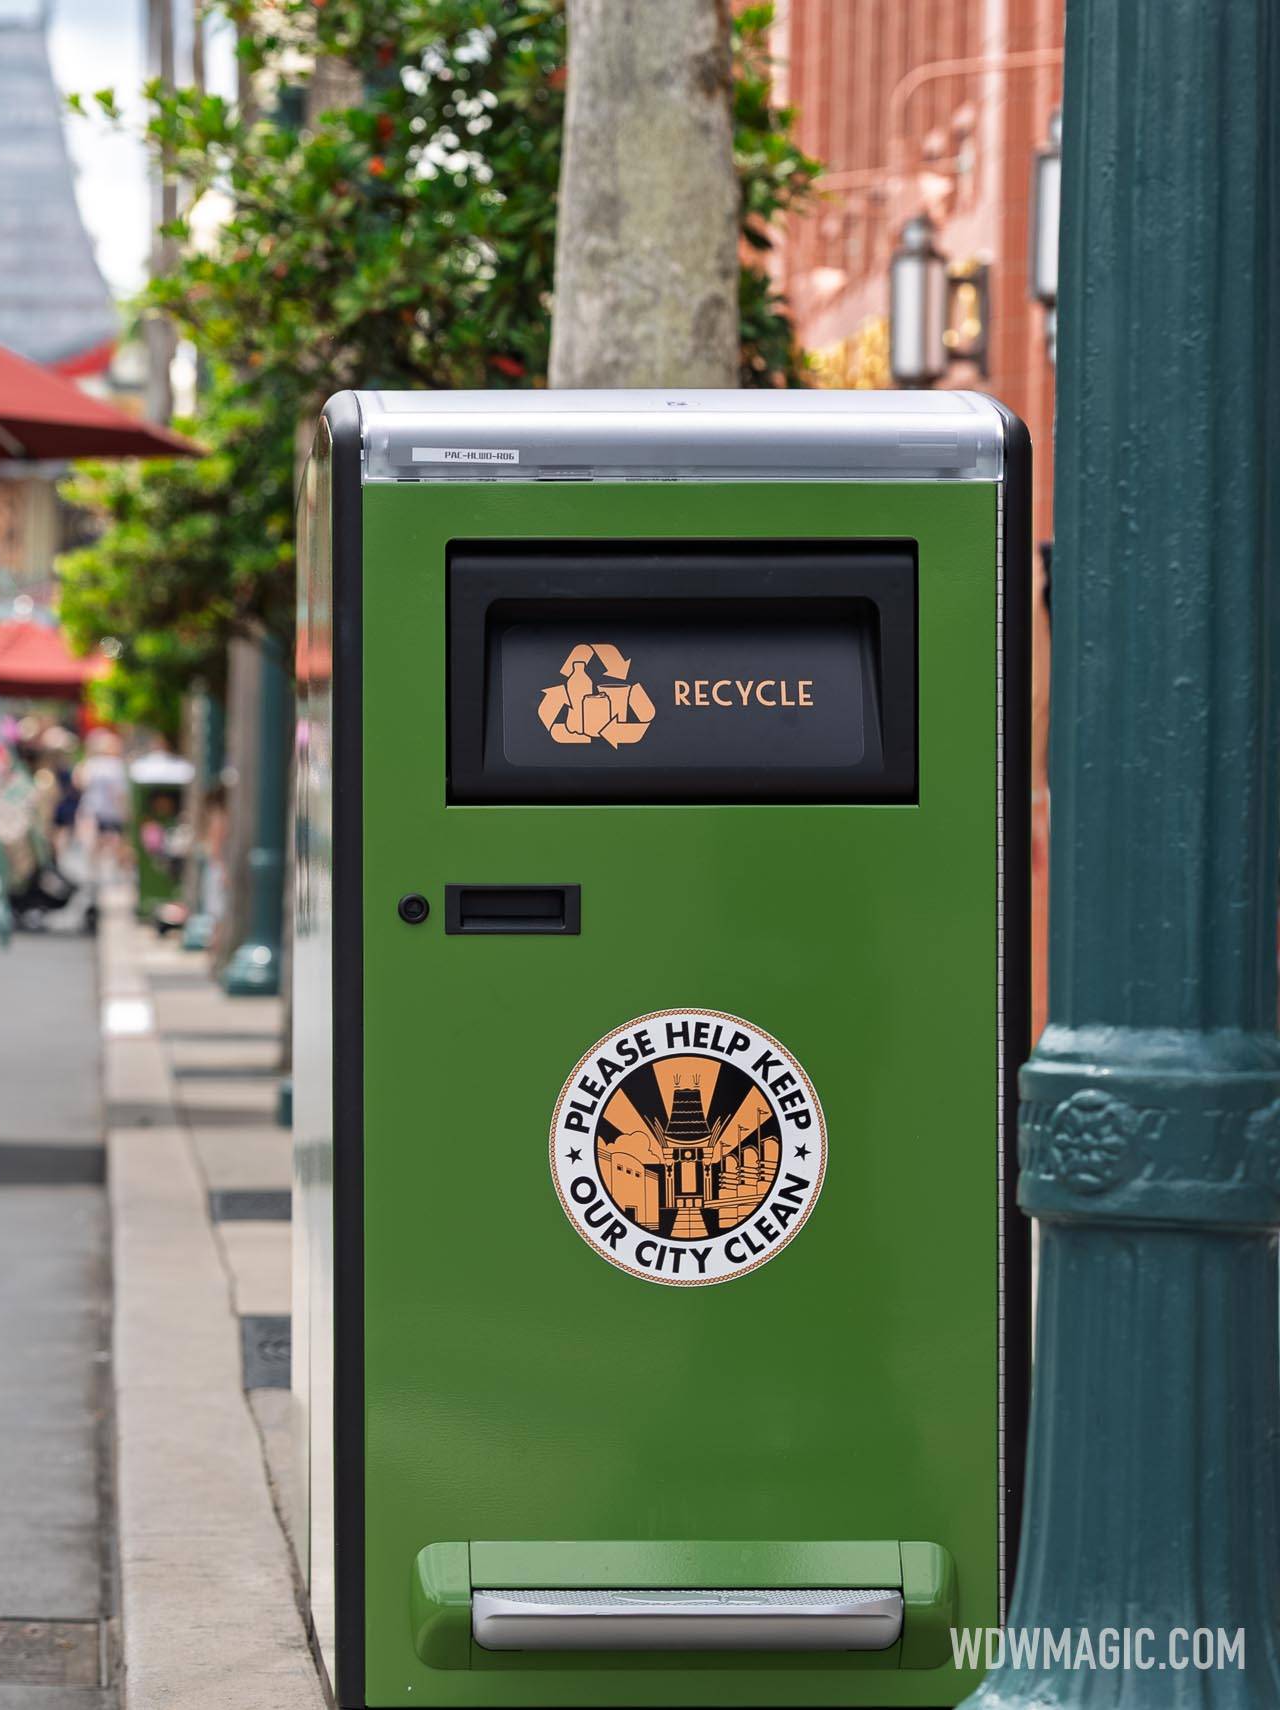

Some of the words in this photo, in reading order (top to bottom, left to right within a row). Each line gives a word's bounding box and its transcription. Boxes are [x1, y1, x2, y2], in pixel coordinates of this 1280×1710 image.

[674, 680, 814, 706] RECYCLE
[564, 1030, 656, 1134] PLEASE
[666, 1021, 751, 1057] HELP
[751, 1050, 812, 1131] KEEP
[570, 1176, 628, 1251] OUR
[635, 1240, 713, 1274] CITY
[725, 1173, 811, 1264] CLEAN
